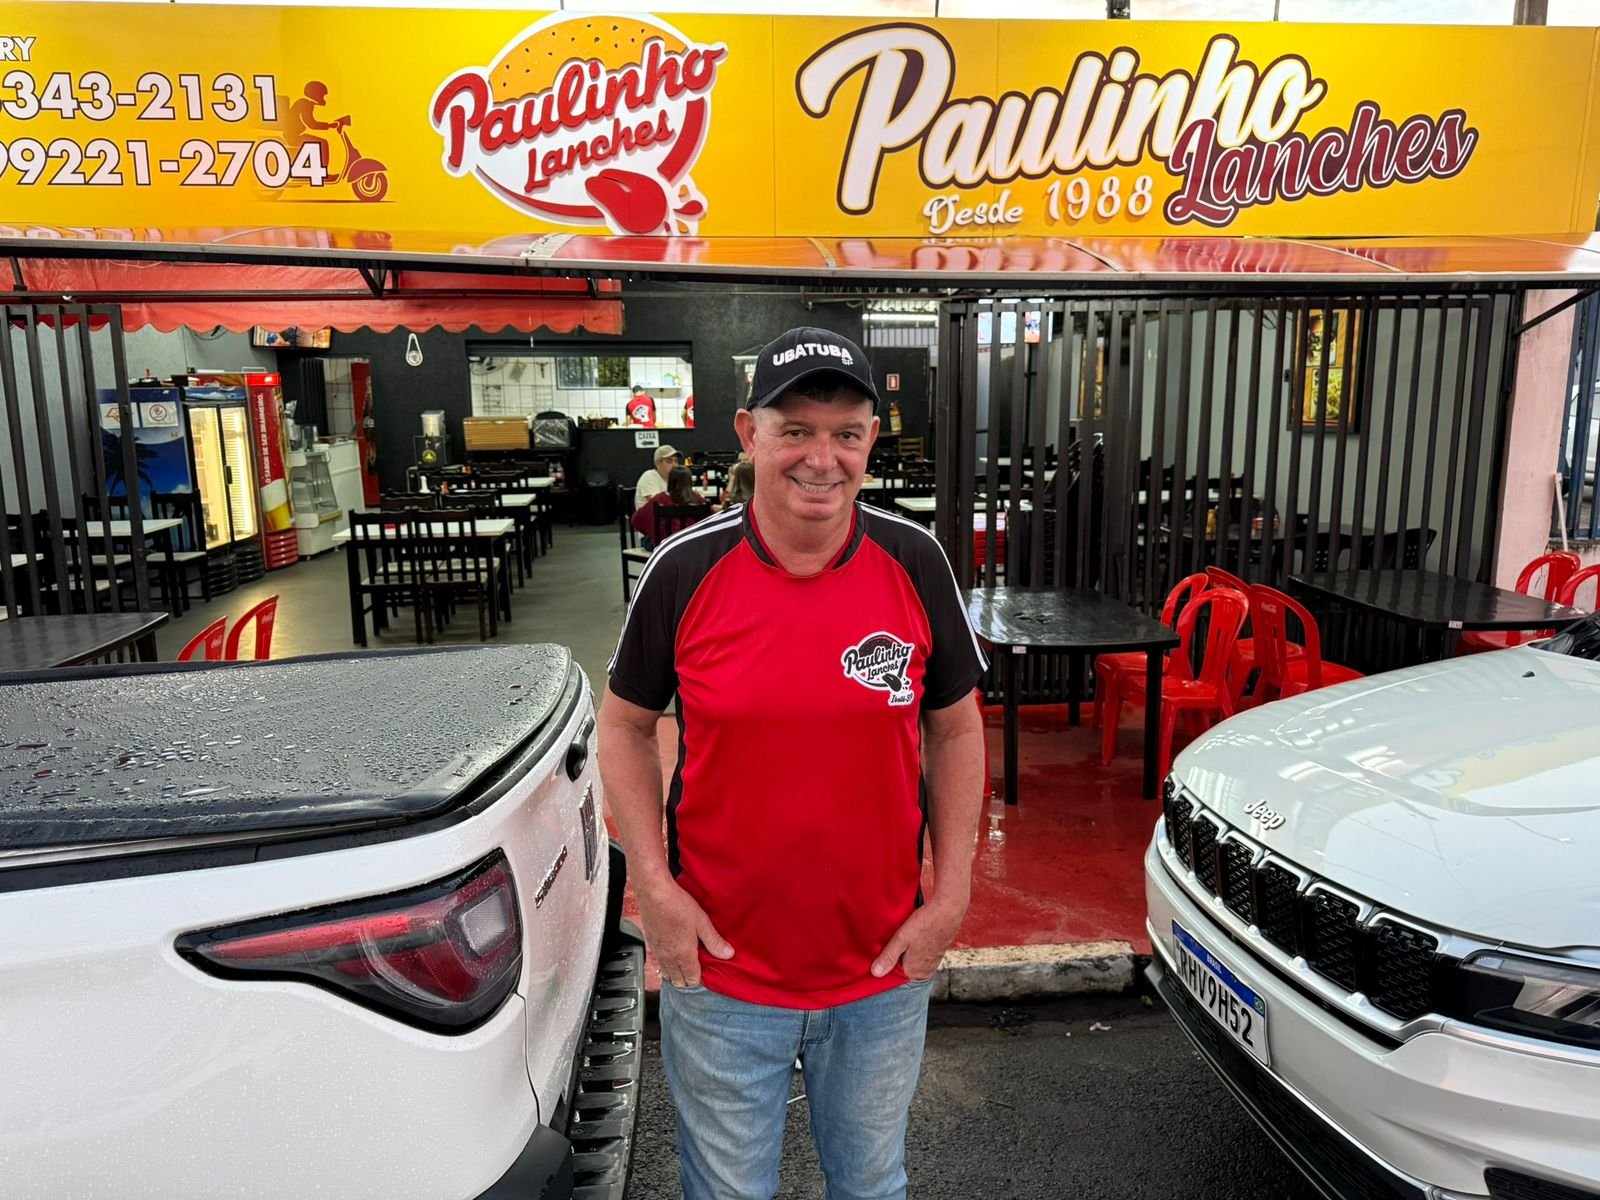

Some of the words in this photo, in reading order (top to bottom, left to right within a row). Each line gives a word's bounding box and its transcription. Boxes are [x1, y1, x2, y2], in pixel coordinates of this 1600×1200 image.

[0, 69, 278, 122] 343-2131
[433, 42, 726, 168] Paulinho
[796, 22, 1328, 215] Paulinho
[0, 137, 328, 188] 9221-2704
[524, 110, 677, 193] Lanches
[1164, 101, 1479, 225] Lanches
[922, 195, 1024, 236] Desde
[1047, 174, 1154, 222] 1988
[772, 343, 853, 366] UBATUBA
[843, 644, 912, 675] Paulinho
[867, 660, 899, 681] Lanches
[1243, 800, 1286, 830] Jeep
[1178, 944, 1254, 1048] RHV9H52
